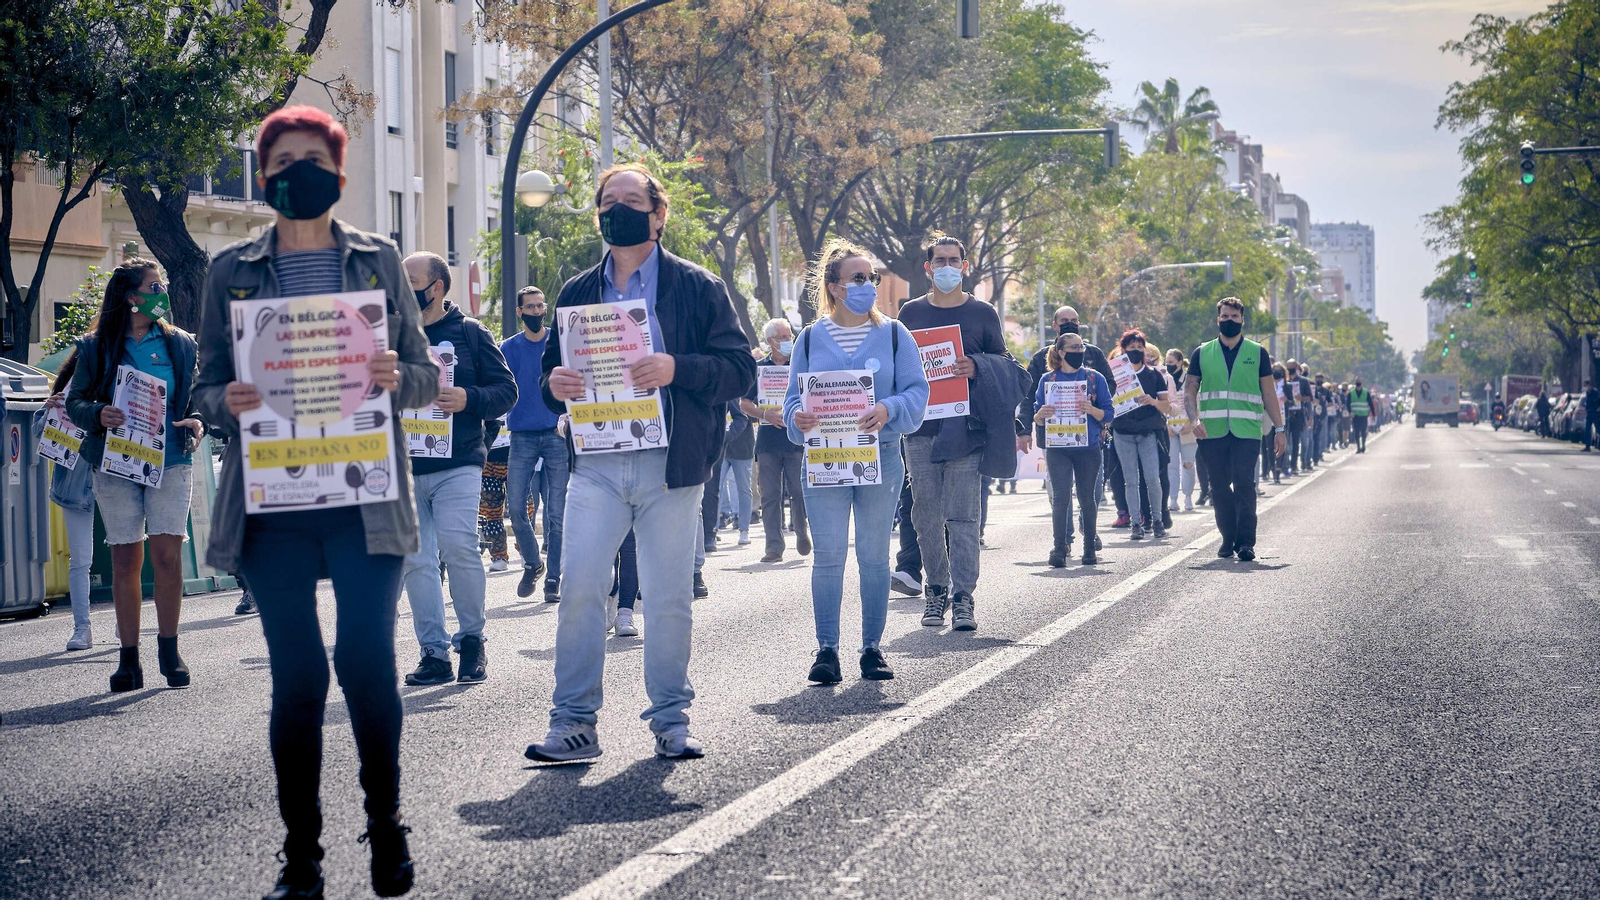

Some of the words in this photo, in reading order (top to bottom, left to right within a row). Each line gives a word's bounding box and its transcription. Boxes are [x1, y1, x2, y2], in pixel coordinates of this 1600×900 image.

[279, 314, 294, 324] EN
[298, 310, 346, 323] BÉLGICA
[591, 312, 621, 322] BÉLGICA
[276, 330, 296, 342] LAS
[298, 326, 352, 339] EMPRESAS
[592, 324, 626, 334] EMPRESAS
[574, 348, 598, 356] PLANES
[600, 343, 637, 353] ESPECIALES
[926, 347, 951, 360] AYUDAS
[264, 357, 306, 370] PLANES
[308, 353, 367, 368] ESPECIALES
[575, 410, 589, 418] EN
[593, 405, 633, 417] ESPAÑA
[638, 404, 653, 412] NO
[111, 441, 122, 450] EN
[124, 444, 150, 458] ESPAÑA
[152, 452, 160, 461] NO
[255, 448, 278, 460] EN
[287, 441, 351, 459] ESPAÑA
[357, 438, 380, 452] NO
[824, 450, 856, 459] ESPAÑA
